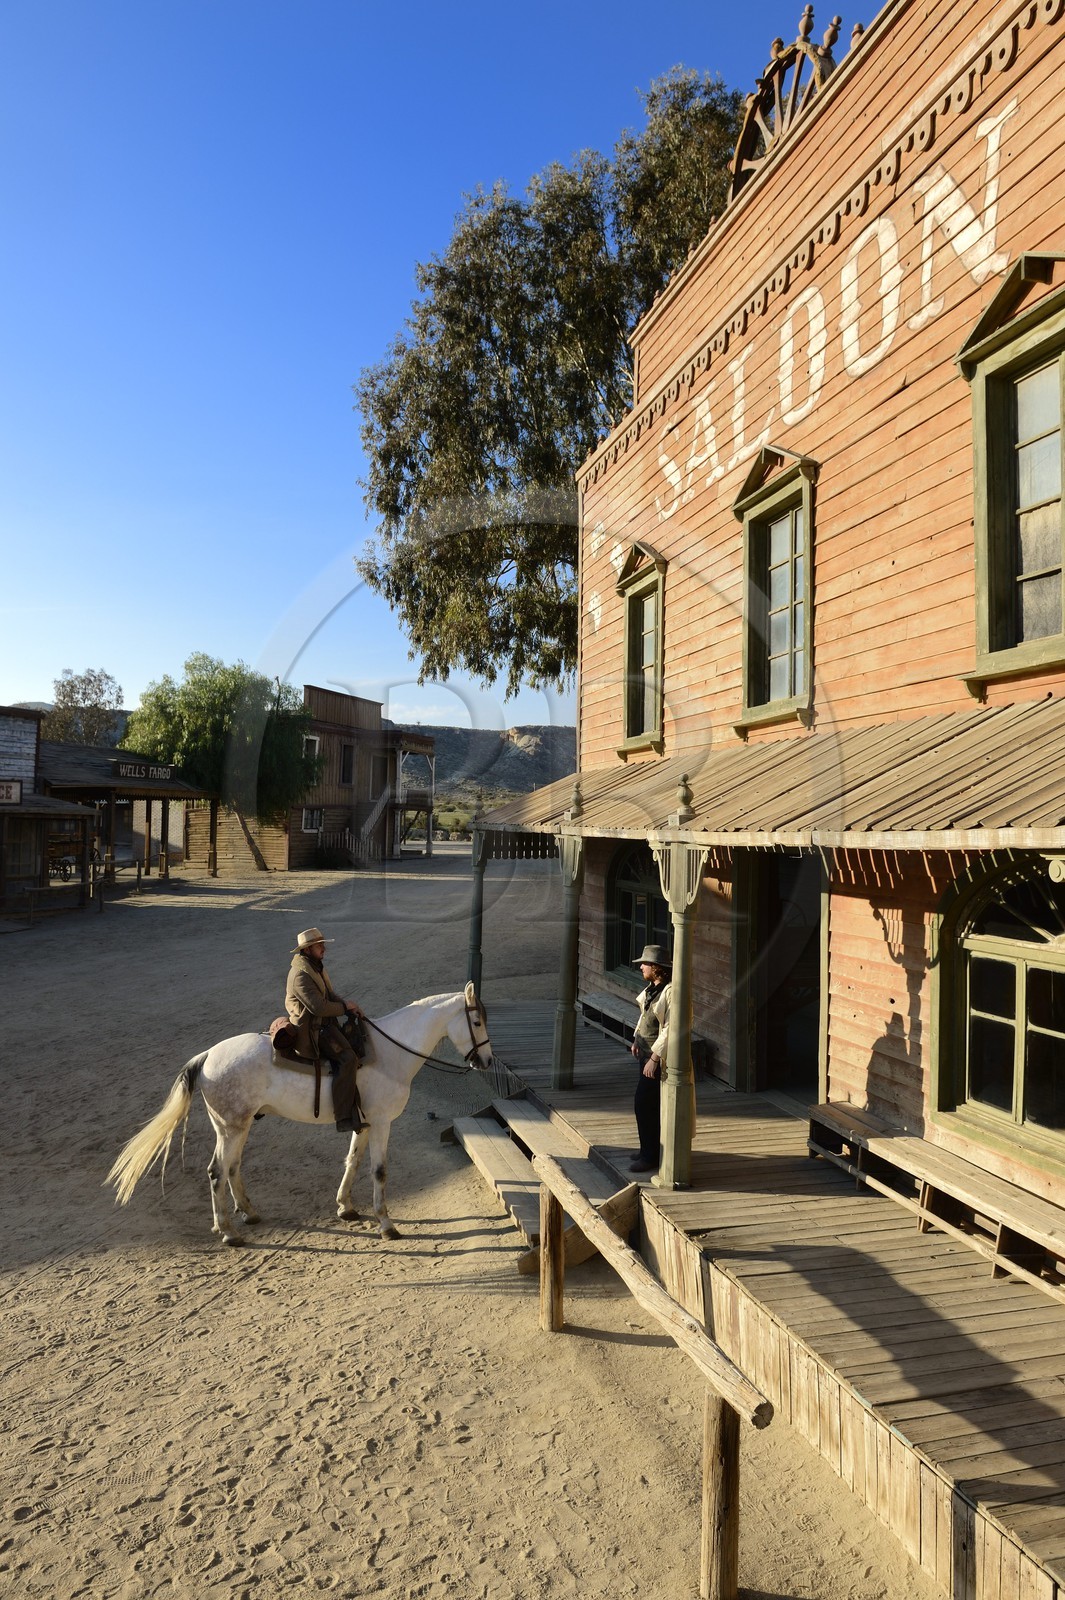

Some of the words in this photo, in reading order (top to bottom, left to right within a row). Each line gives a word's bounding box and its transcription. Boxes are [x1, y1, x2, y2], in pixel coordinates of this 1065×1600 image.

[655, 97, 1020, 521] SALOON
[120, 764, 146, 778] WELLS
[149, 766, 171, 780] FARGO
